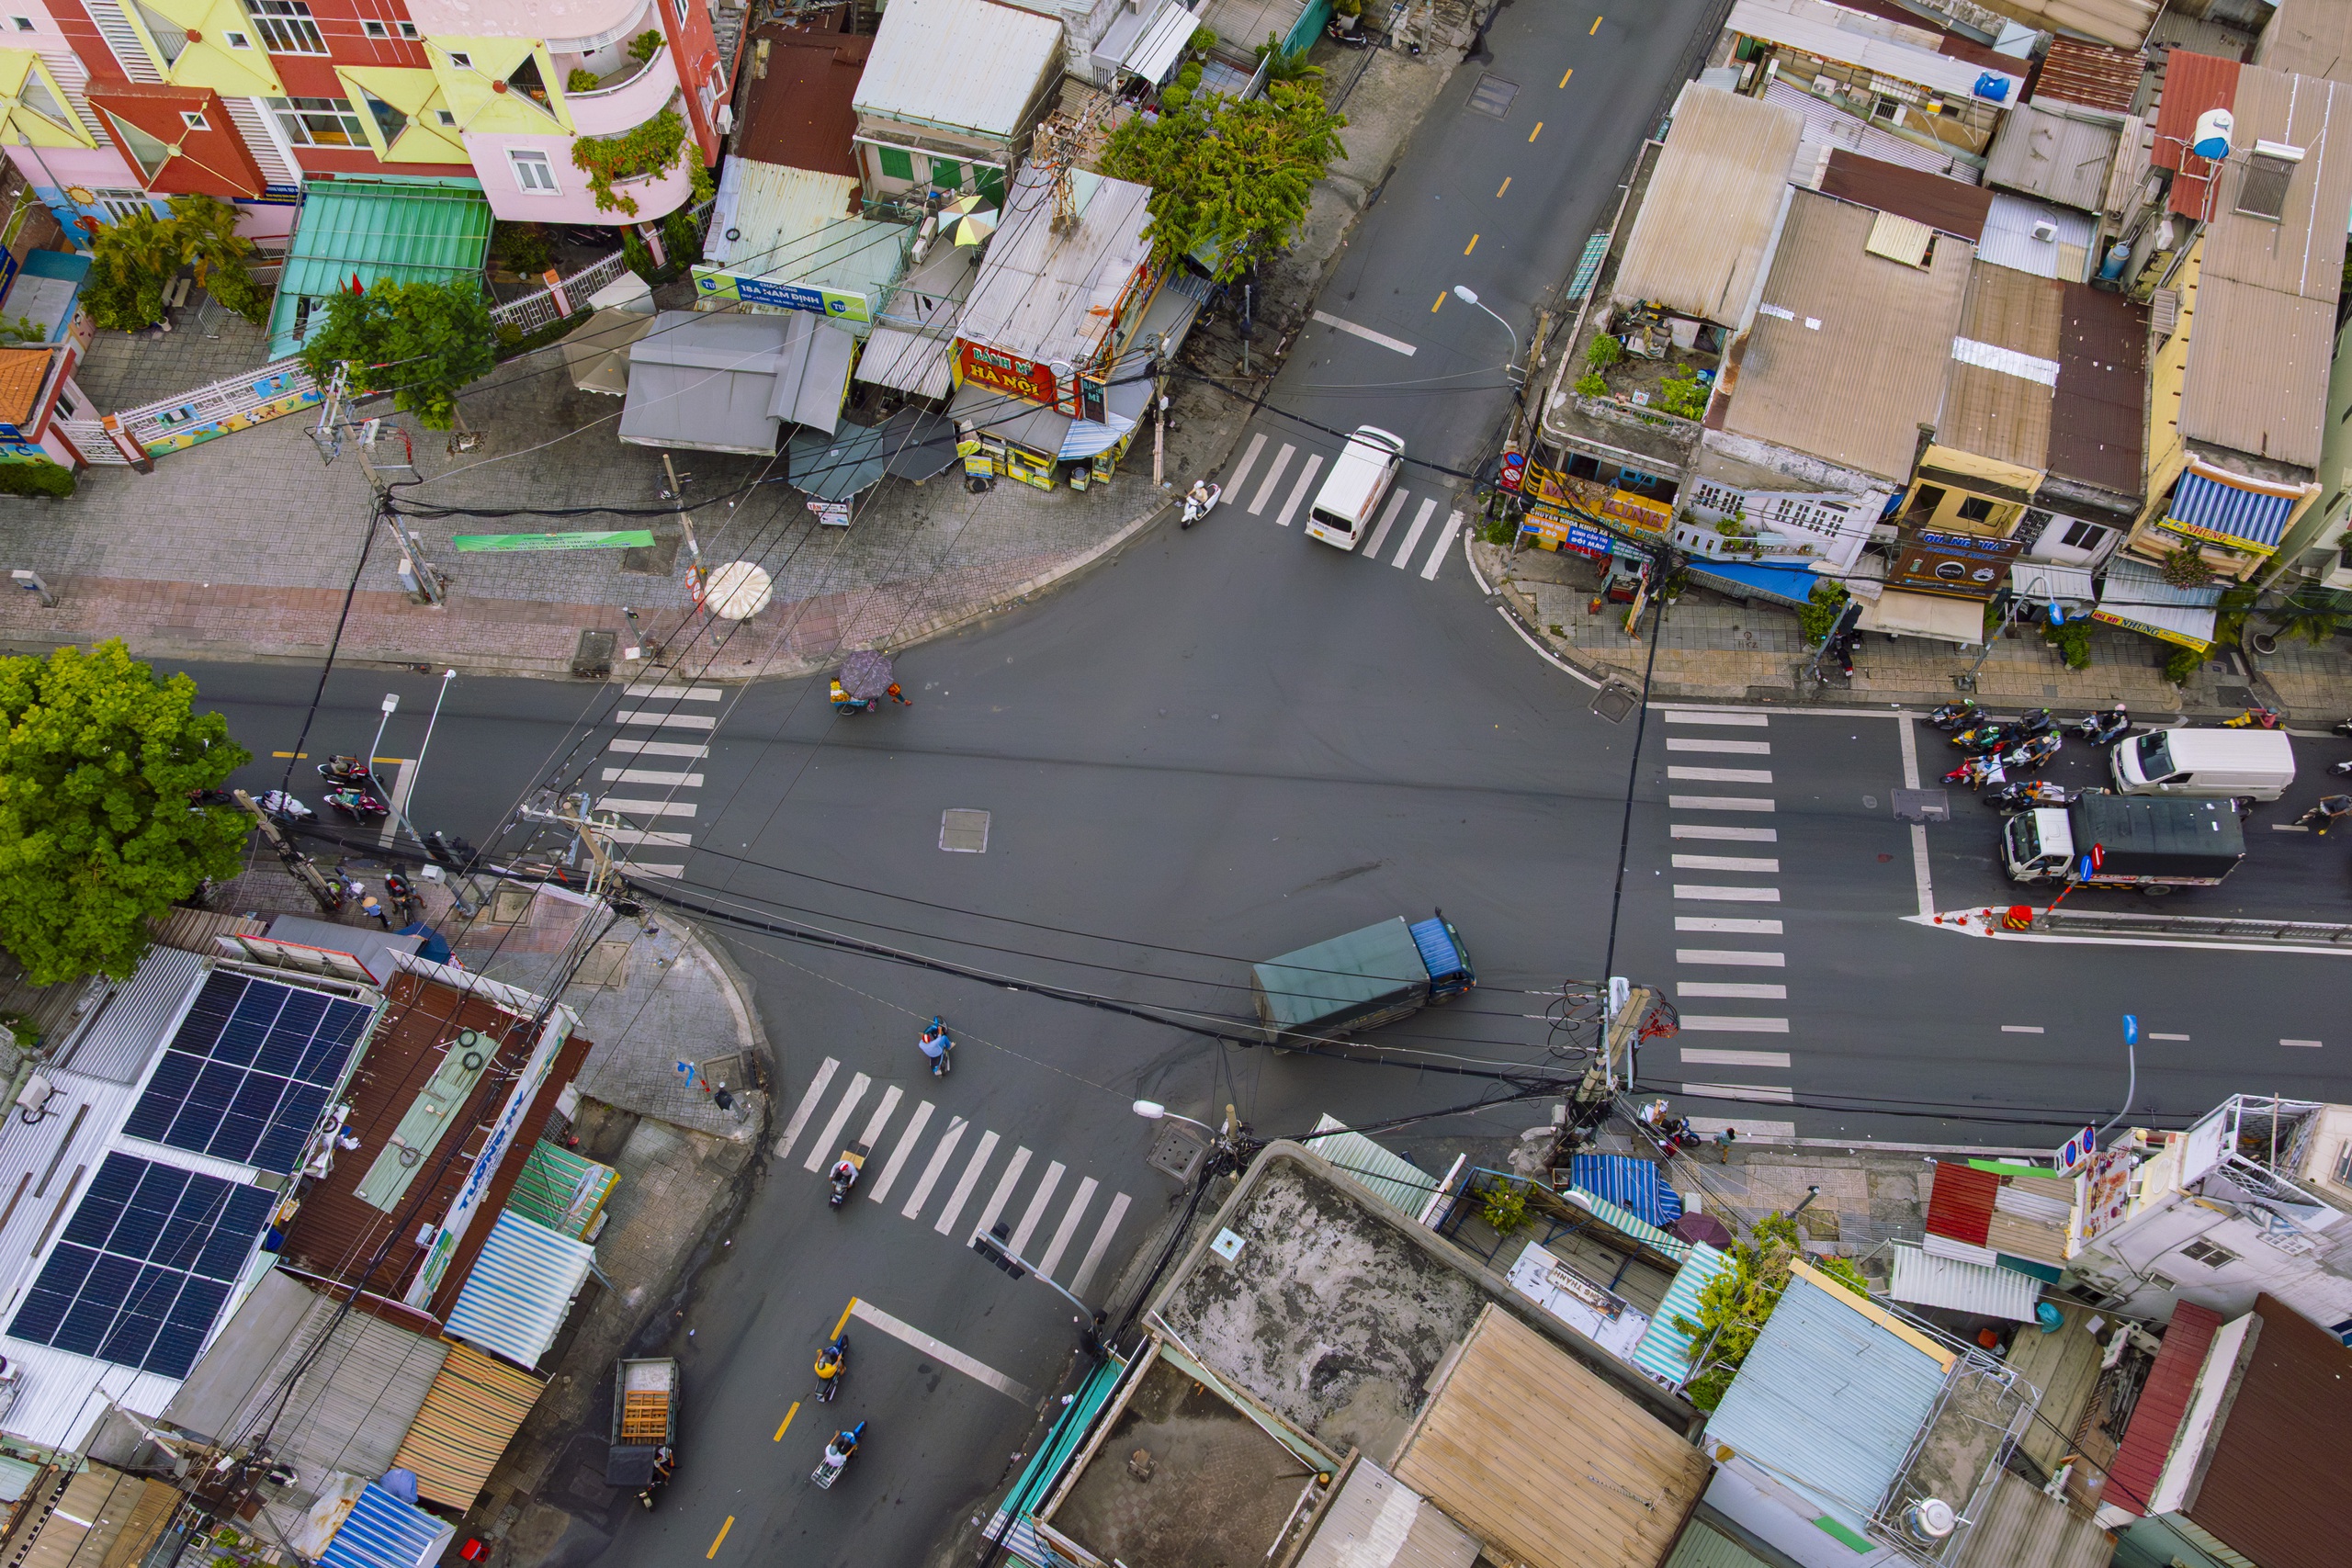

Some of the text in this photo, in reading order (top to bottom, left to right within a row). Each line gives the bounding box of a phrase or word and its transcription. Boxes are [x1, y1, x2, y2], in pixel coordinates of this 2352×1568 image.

[741, 285, 820, 304] 18A NAM ĐỊNH
[972, 347, 1012, 370] BÁNH
[969, 364, 1040, 396] HÀ NỘI
[1559, 517, 1578, 527] KHOA
[1603, 497, 1668, 529] KÍNH
[1924, 533, 1972, 547] QUNG
[2186, 525, 2228, 542] NHUNG
[2120, 618, 2160, 637] NHUNG
